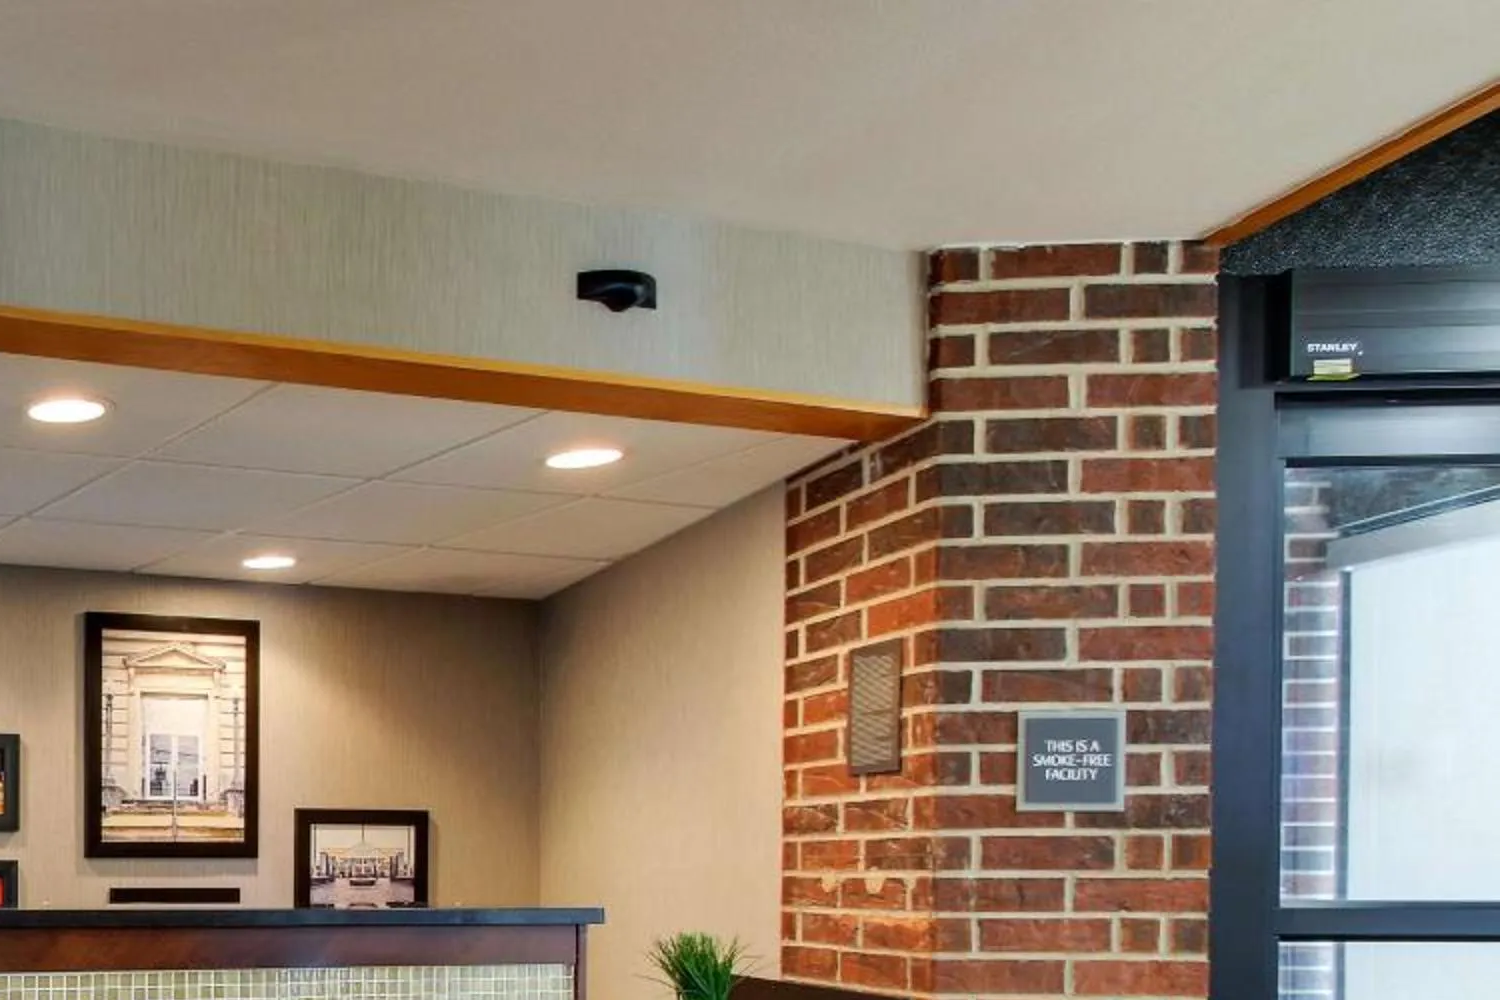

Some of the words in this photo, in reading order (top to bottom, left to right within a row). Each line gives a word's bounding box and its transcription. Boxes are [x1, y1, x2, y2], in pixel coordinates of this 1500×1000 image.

[1307, 343, 1357, 353] STANLEY
[1044, 739, 1074, 753] THIS
[1075, 739, 1088, 753] IS
[1089, 739, 1101, 753] A
[1032, 753, 1113, 767] SMOKE-FREE
[1045, 767, 1099, 781] FACILITY
